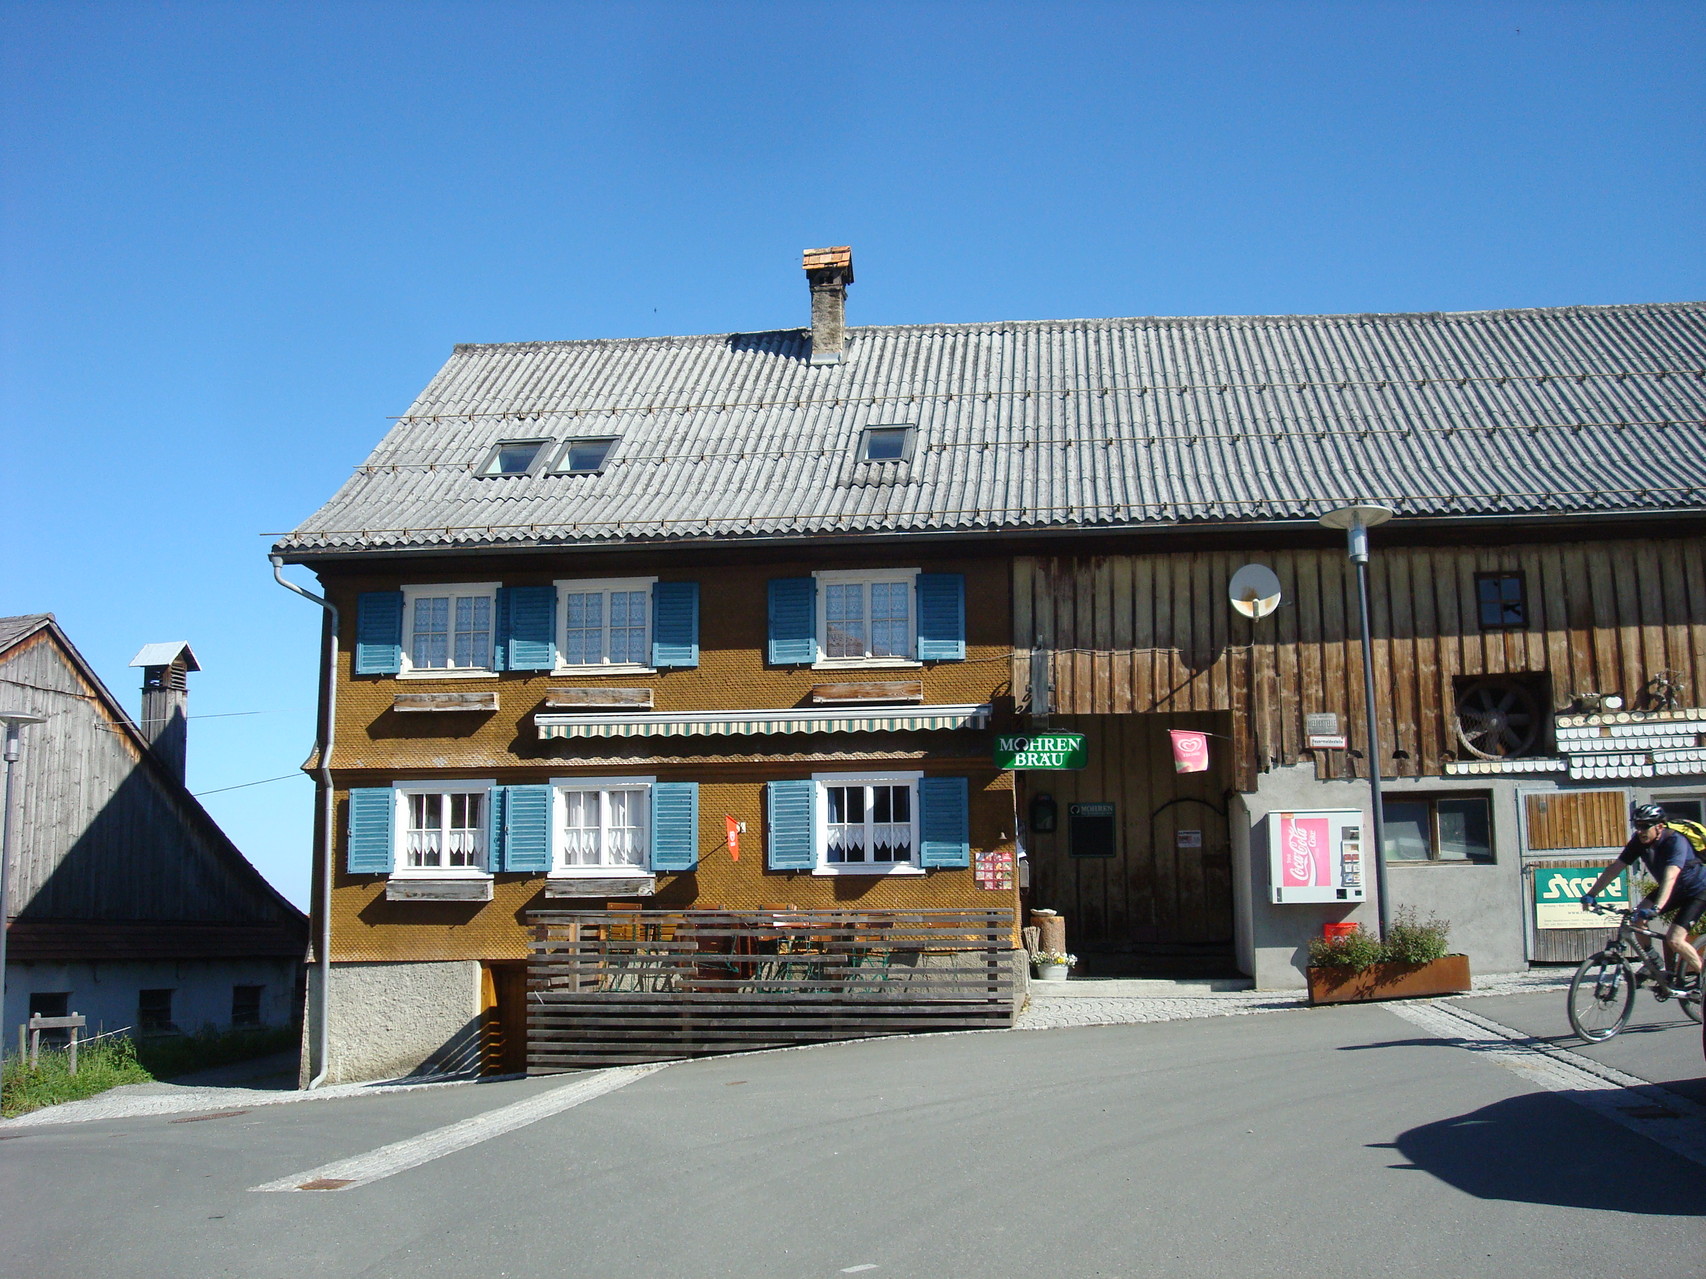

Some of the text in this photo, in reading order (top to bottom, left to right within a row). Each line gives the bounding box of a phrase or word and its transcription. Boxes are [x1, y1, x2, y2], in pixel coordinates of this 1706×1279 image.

[1000, 737, 1082, 752] MOHREN
[1013, 752, 1065, 767] BRÄU
[1288, 826, 1309, 881] Coca-Cola
